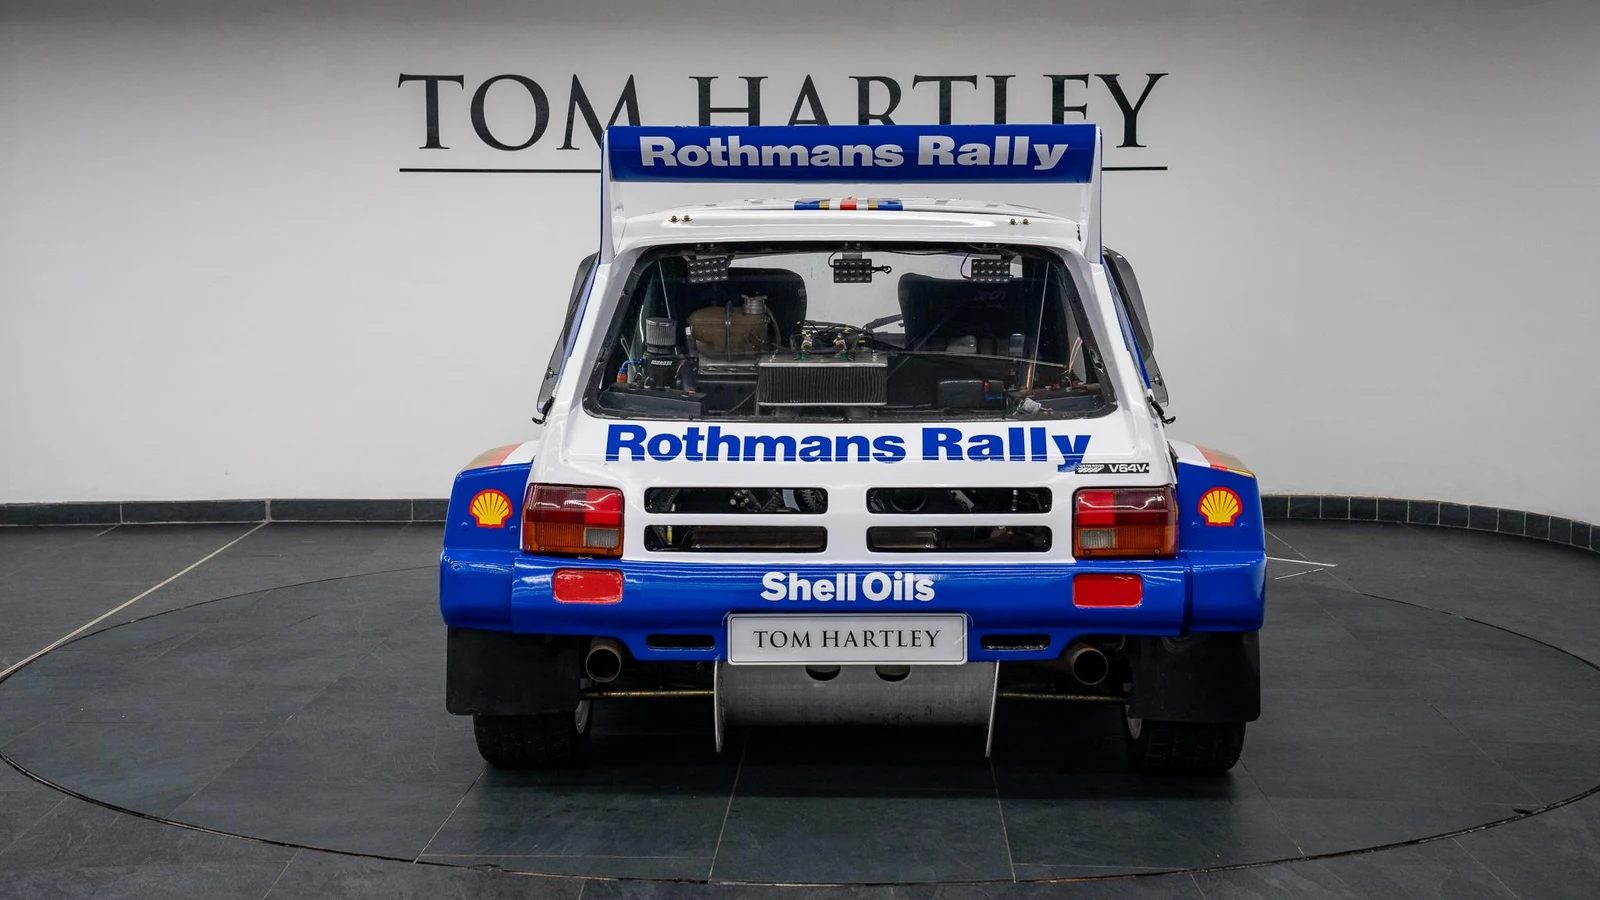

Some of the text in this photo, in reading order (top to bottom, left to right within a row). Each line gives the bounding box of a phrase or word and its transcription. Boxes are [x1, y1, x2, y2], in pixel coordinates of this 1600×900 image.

[398, 74, 642, 151] TOM
[640, 136, 1069, 170] Rothmans Rally
[605, 424, 1091, 472] Rothmans Rally
[760, 571, 935, 602] Shell Oils
[753, 630, 941, 648] TOM HARTLEY
